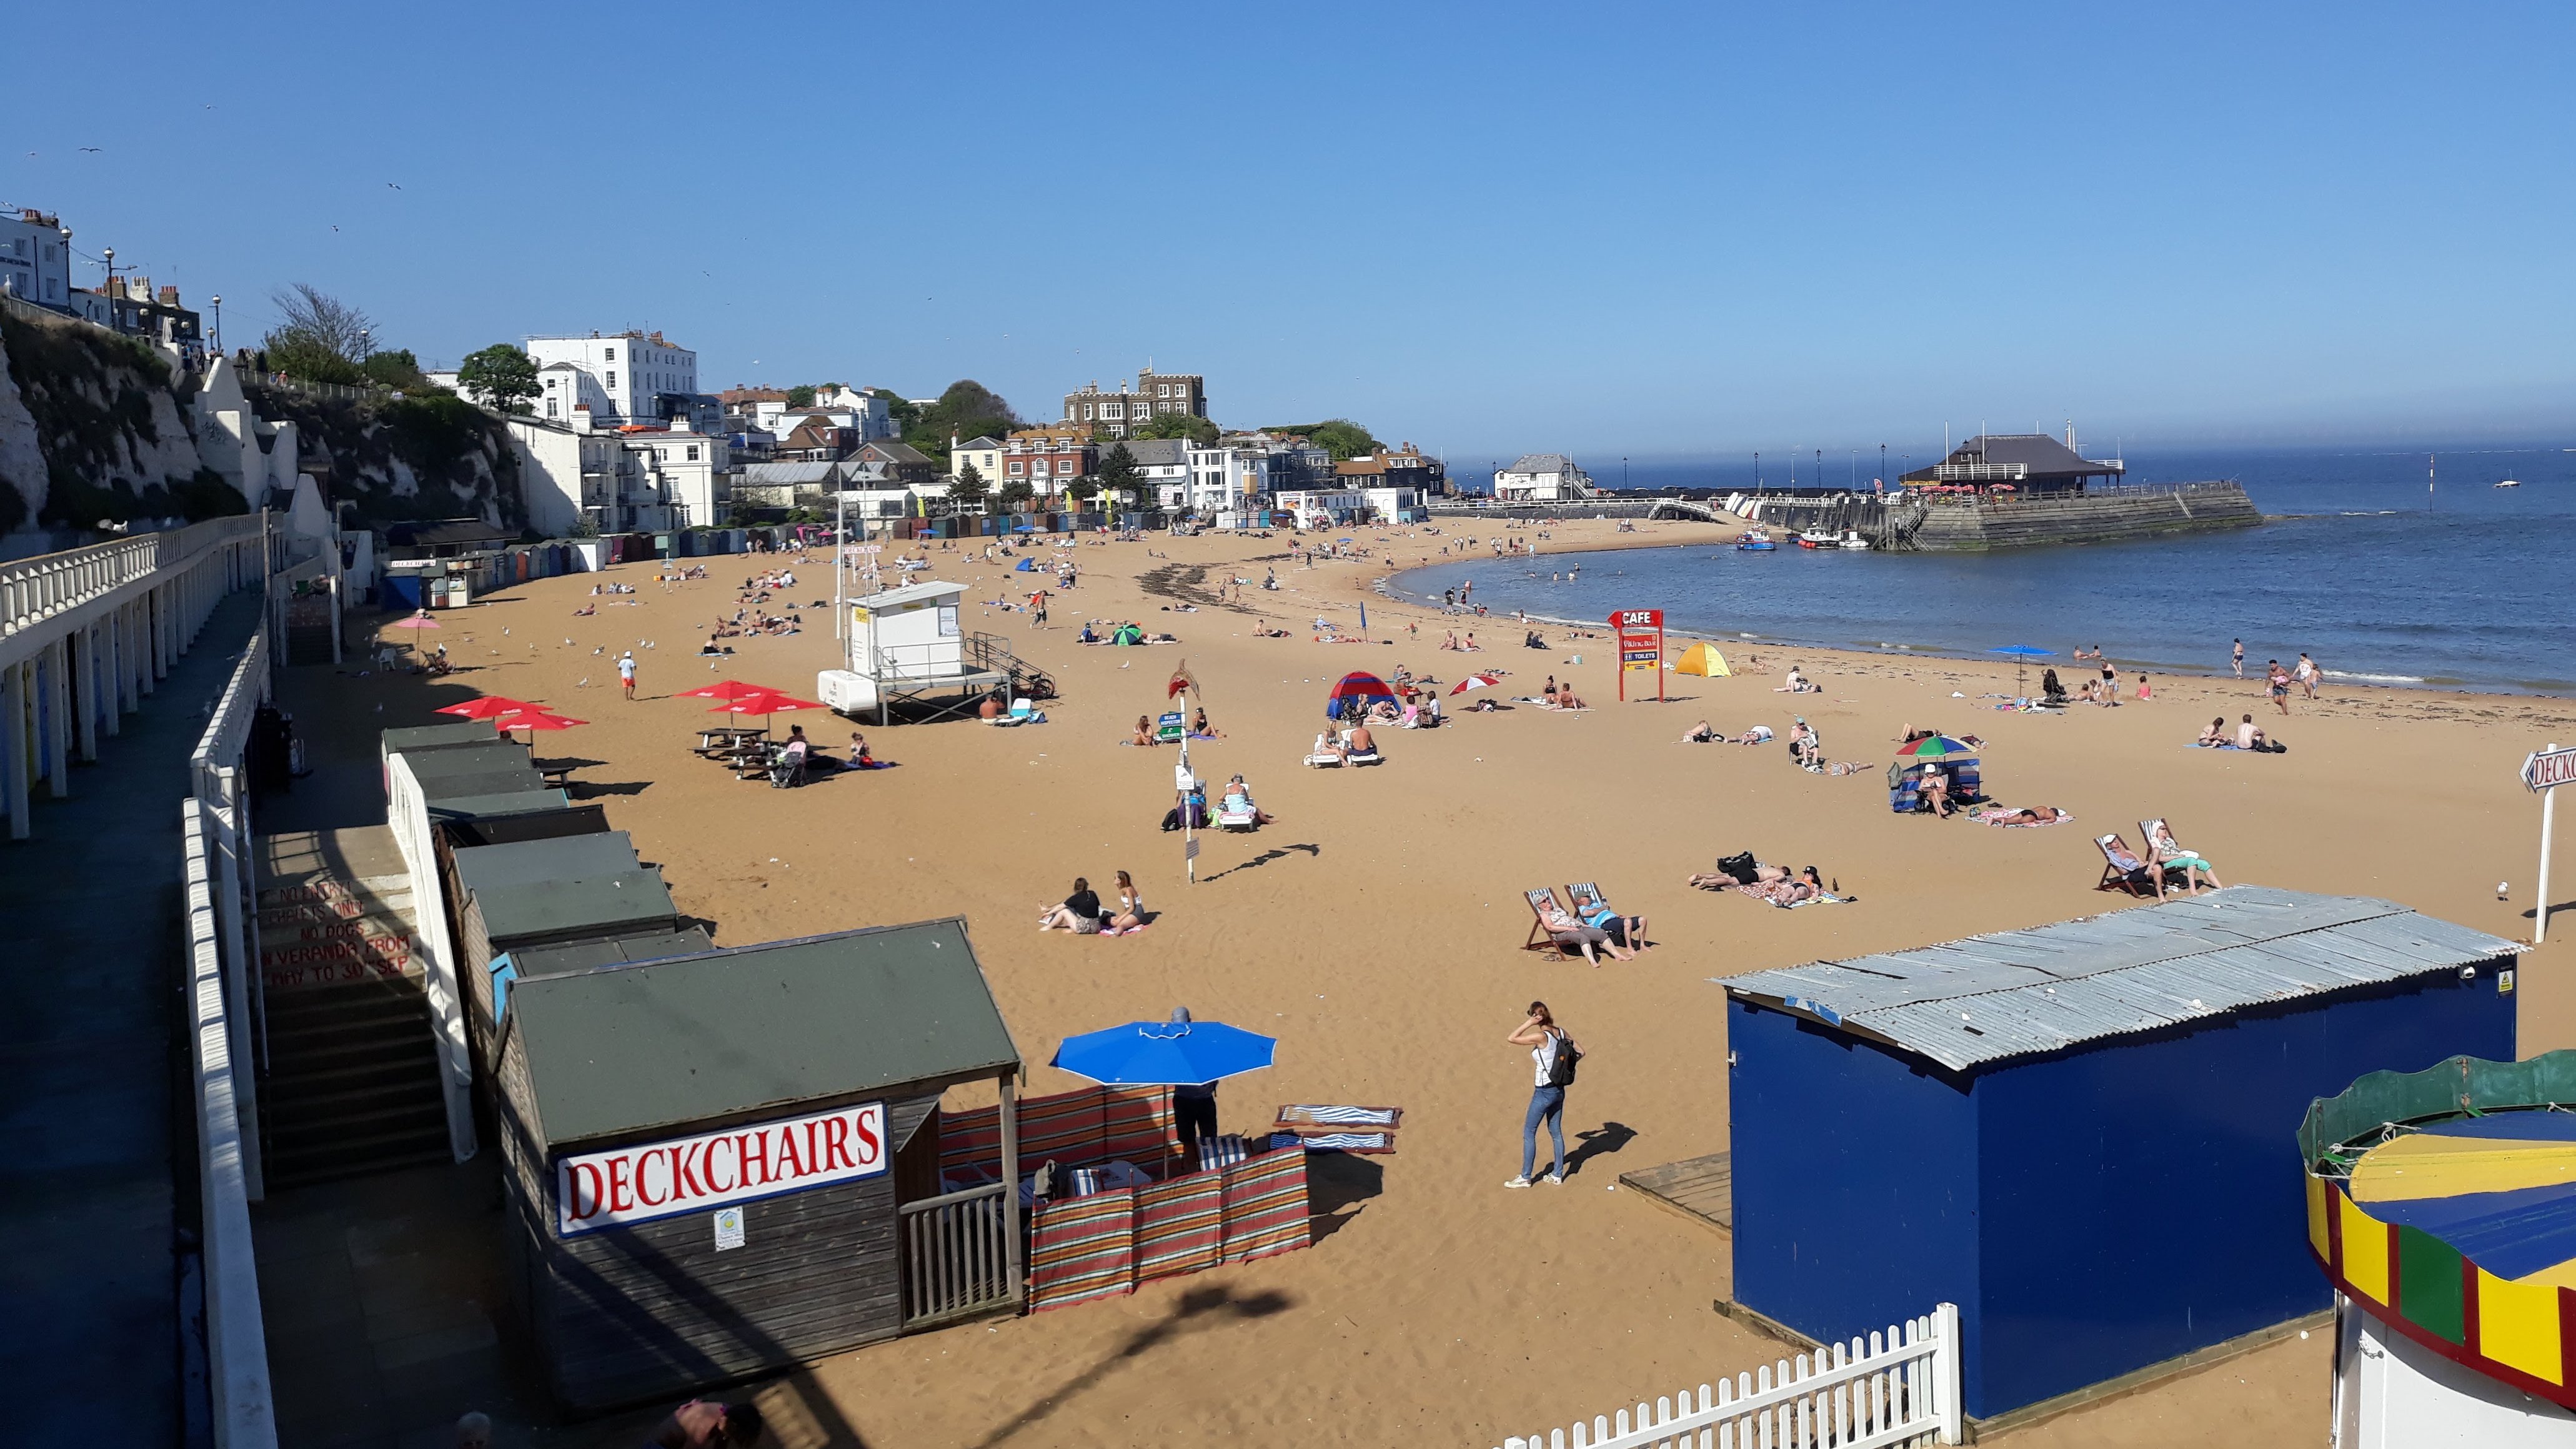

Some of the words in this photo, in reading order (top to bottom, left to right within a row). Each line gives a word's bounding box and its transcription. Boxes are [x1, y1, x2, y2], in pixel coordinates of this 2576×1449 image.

[1623, 612, 1651, 624] CAFE
[281, 887, 297, 901] NO
[333, 900, 364, 918] ONLY
[301, 927, 319, 940] NO
[326, 922, 364, 938] DOGS
[277, 942, 357, 965] VERANDA
[366, 935, 410, 953] FROM
[312, 966, 334, 982] TO
[568, 1110, 880, 1222] DECKCHAIRS
